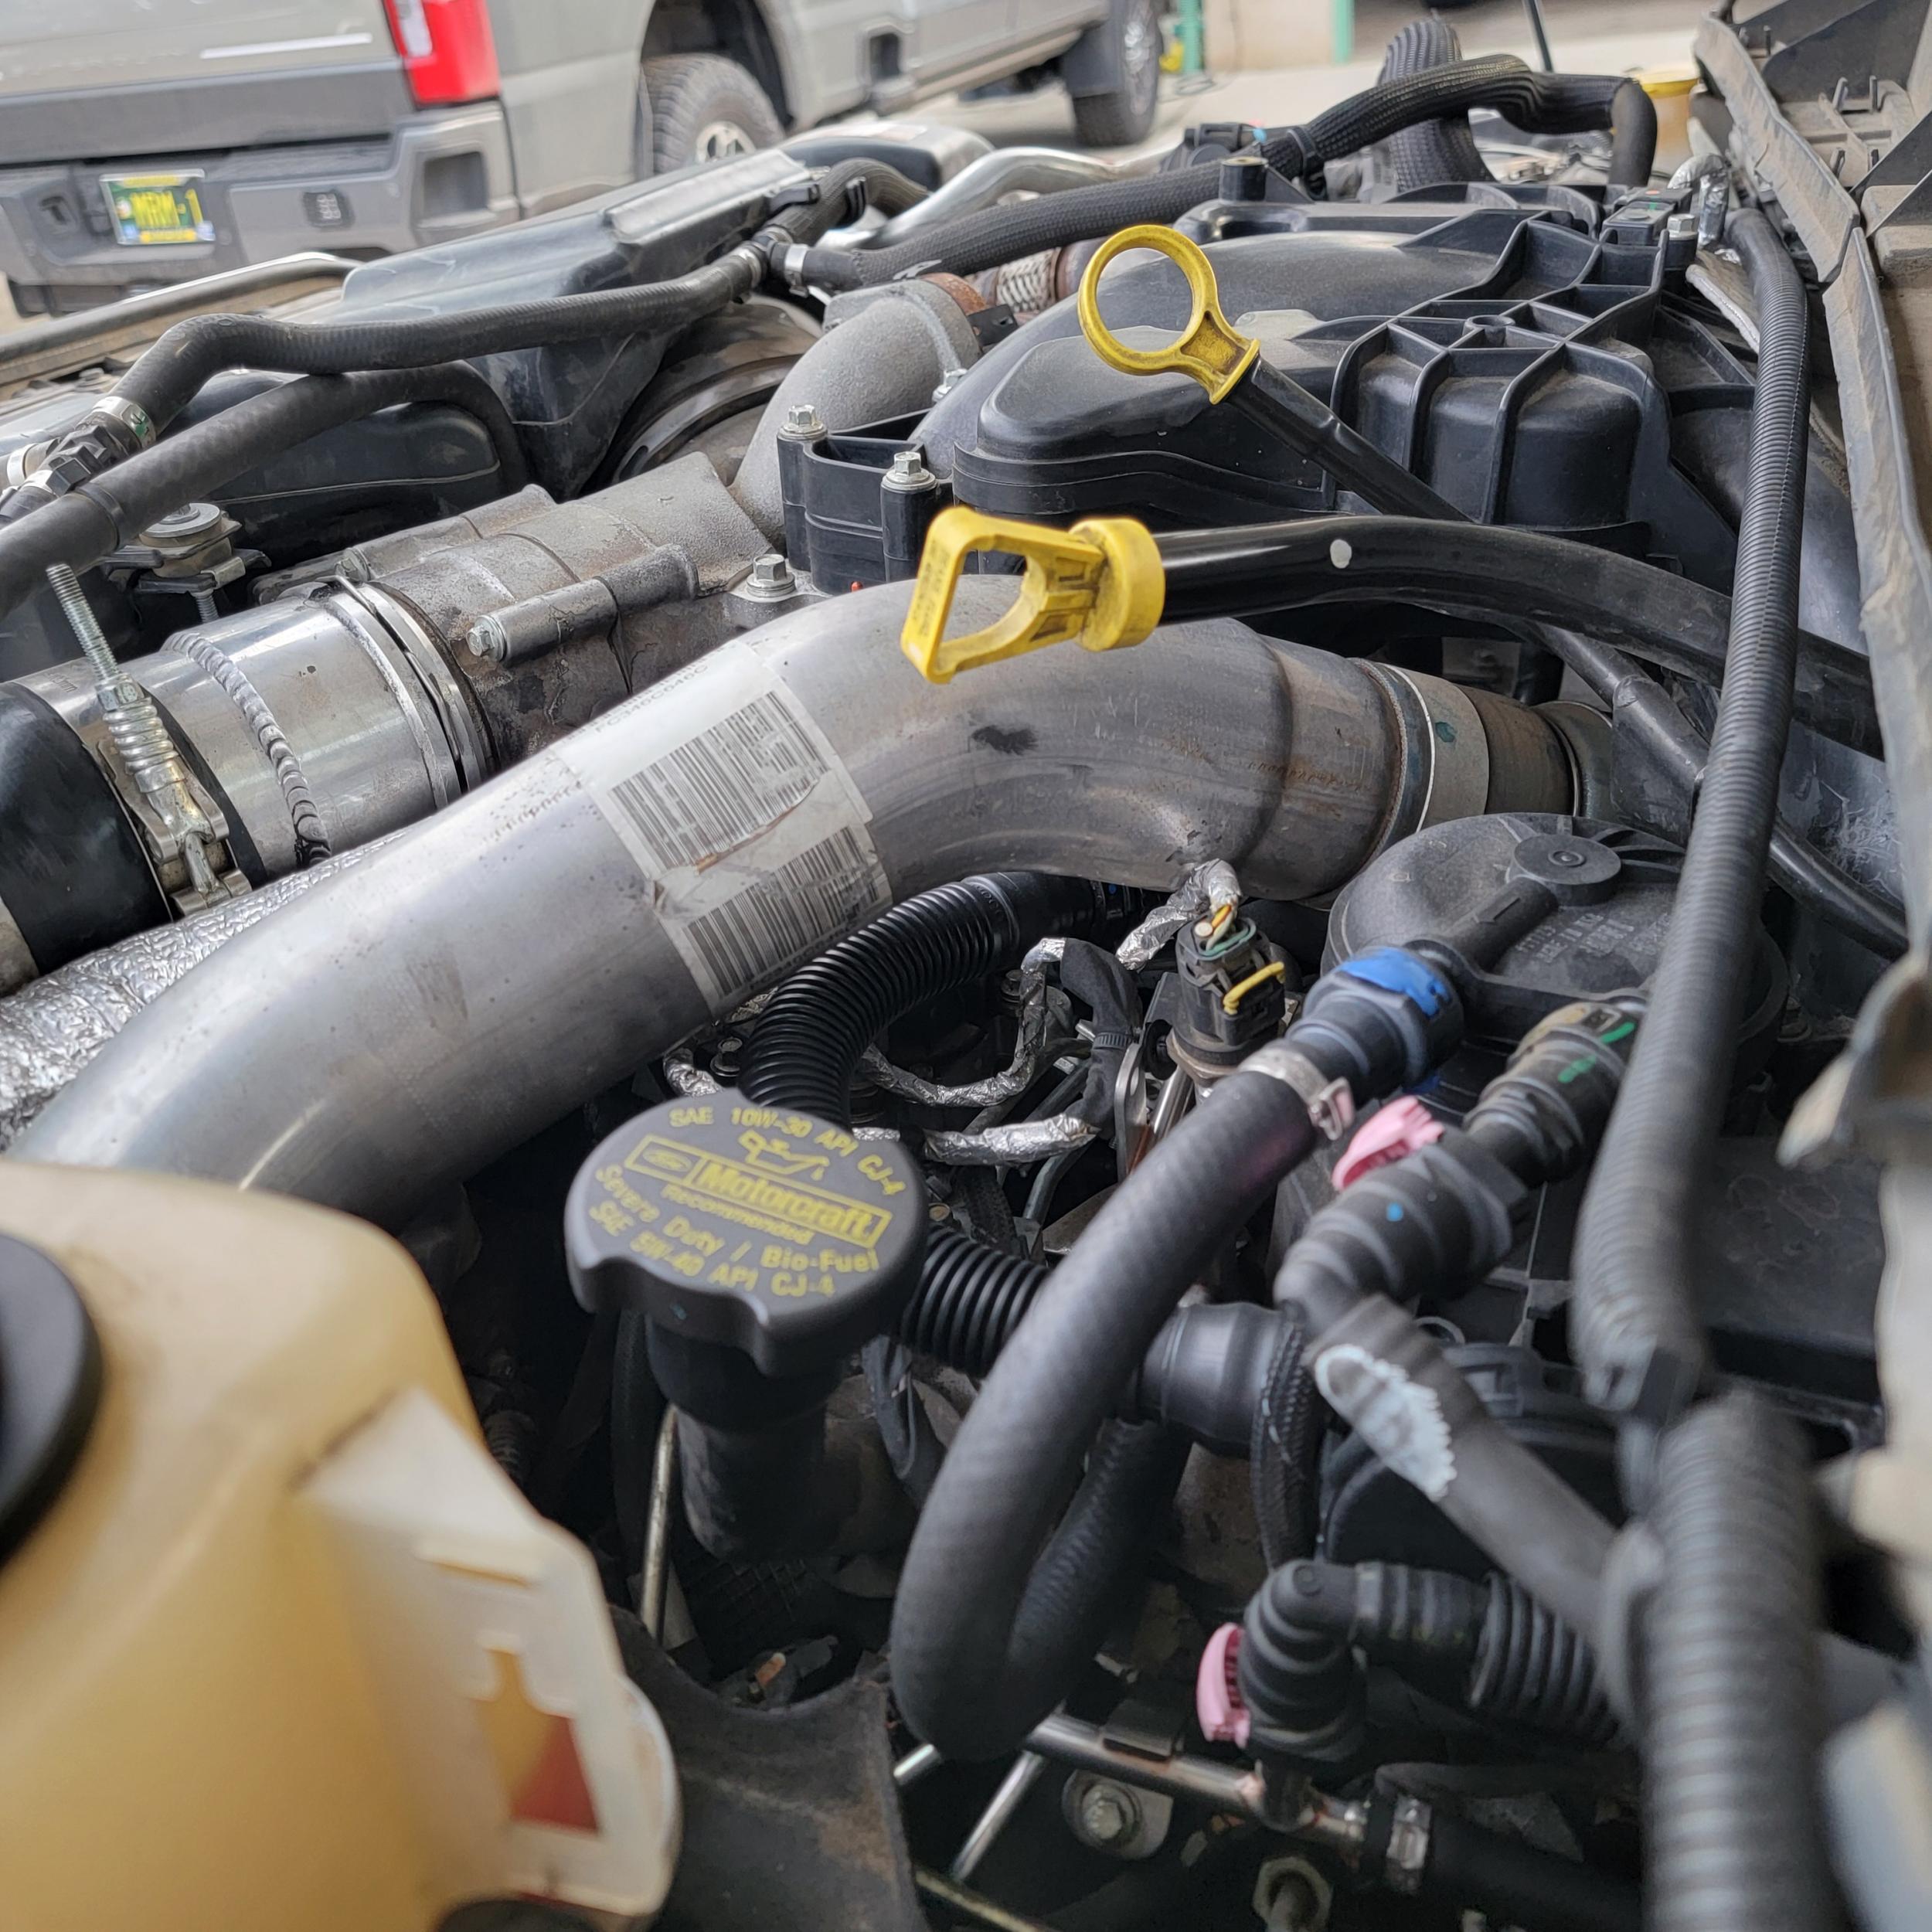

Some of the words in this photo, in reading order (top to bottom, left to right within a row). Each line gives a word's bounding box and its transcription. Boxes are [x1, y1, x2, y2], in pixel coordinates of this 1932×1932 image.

[668, 1107, 714, 1128] SAE
[731, 1107, 813, 1138] 10W-30
[815, 1129, 859, 1156] API
[857, 1155, 907, 1196] CJ-4
[699, 1162, 874, 1234] Motorcraft
[589, 1199, 634, 1236] SAE
[629, 1230, 705, 1277] 5W-40
[708, 1263, 760, 1291] API
[770, 1272, 836, 1298] CJ-4
[595, 1165, 661, 1223] Severe
[662, 1216, 725, 1257] Duty
[760, 1245, 879, 1272] Bio-Fuel
